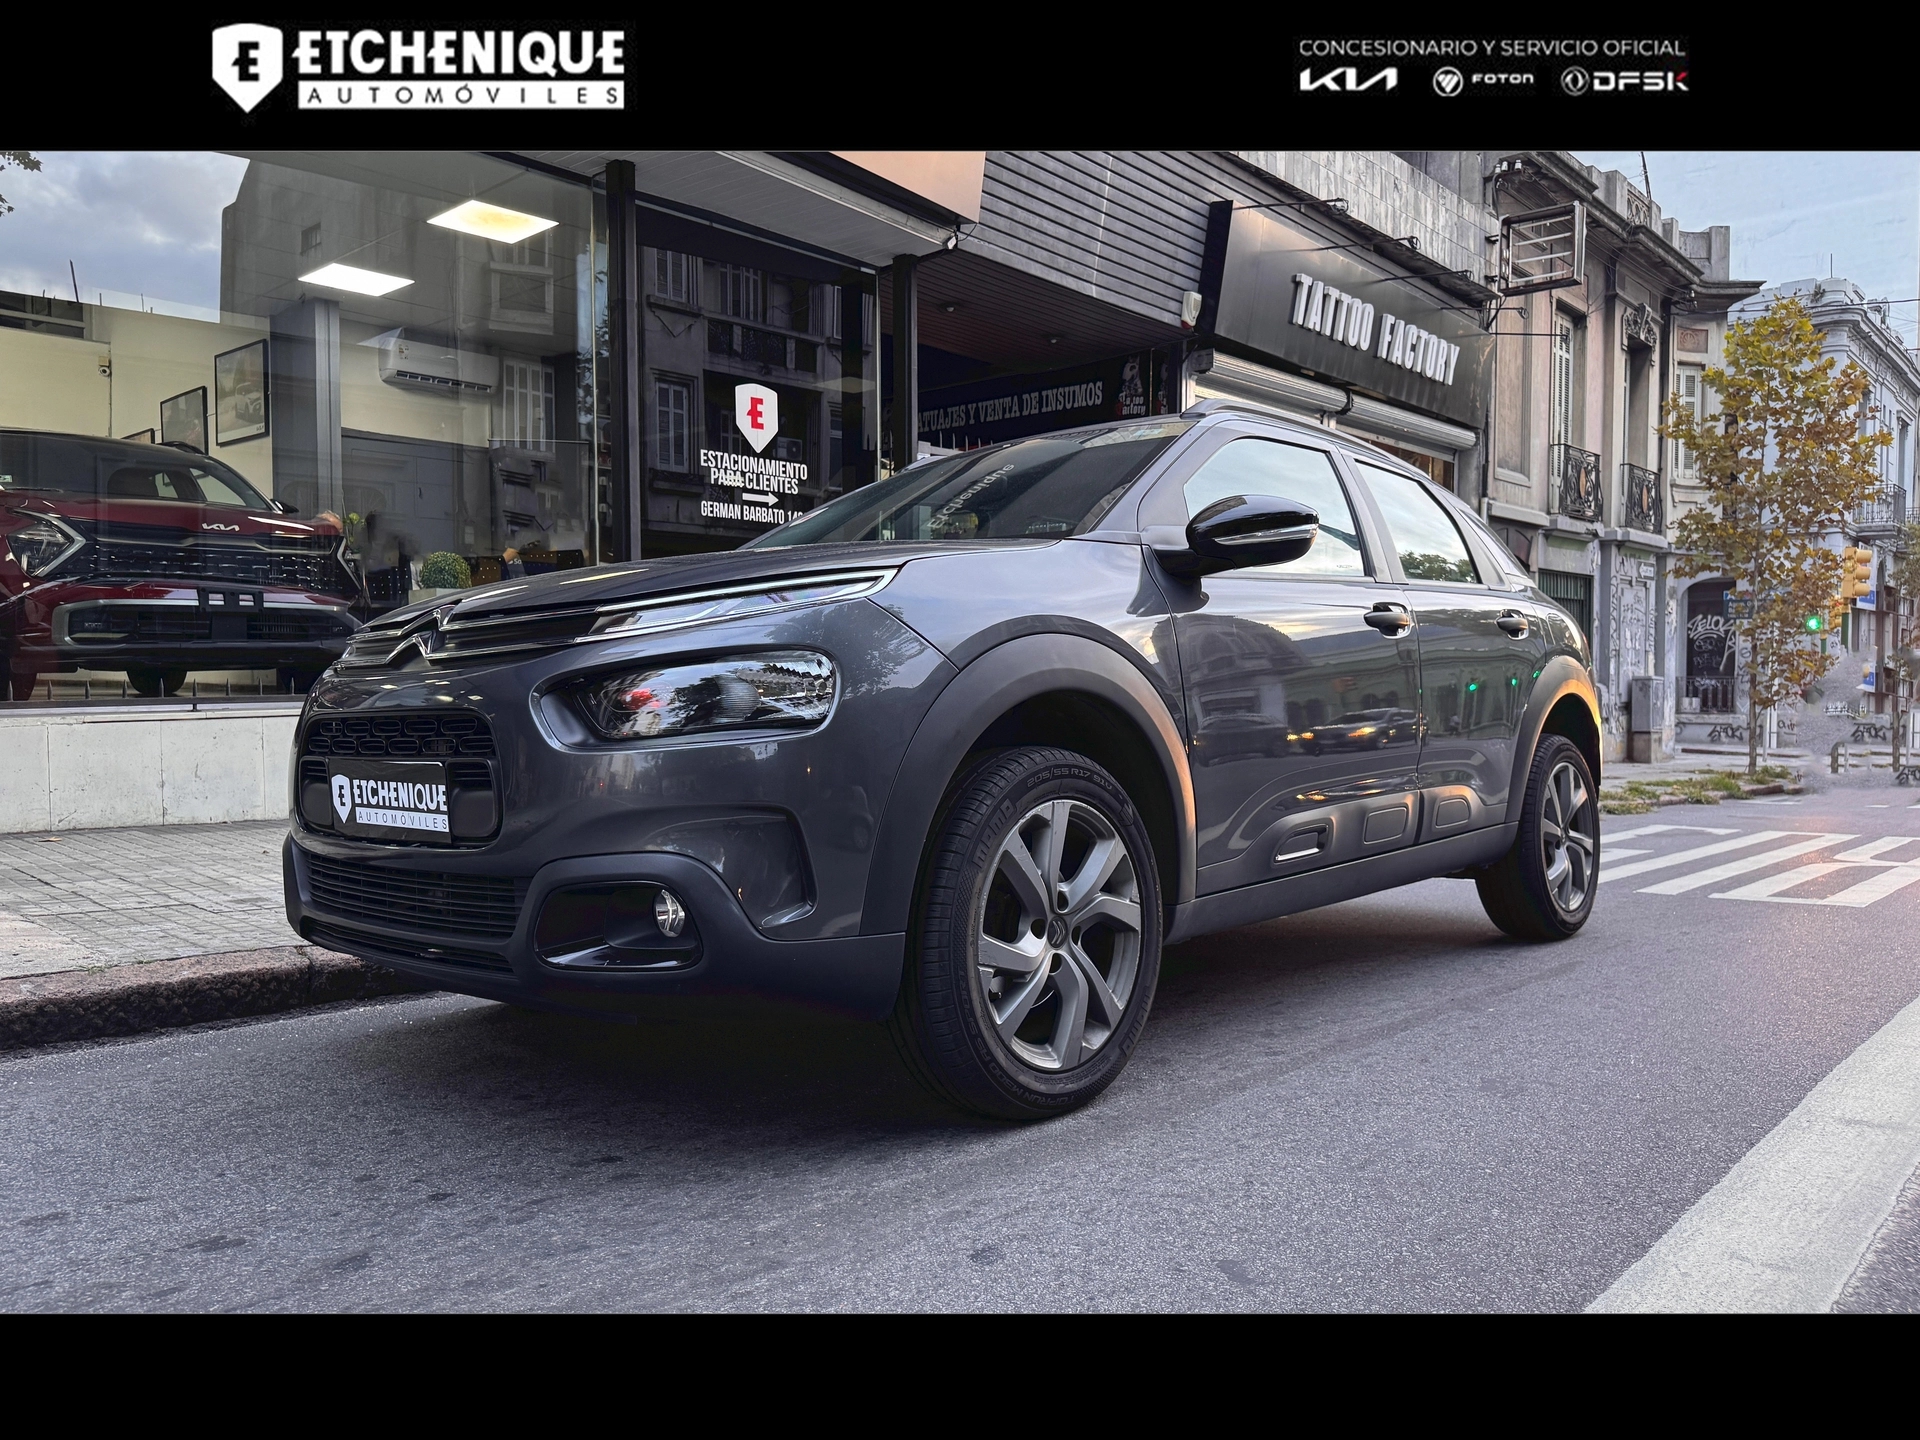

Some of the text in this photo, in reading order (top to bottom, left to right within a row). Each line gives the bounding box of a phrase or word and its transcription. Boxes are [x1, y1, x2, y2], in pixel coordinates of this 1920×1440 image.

[1293, 273, 1461, 386] TATTOO FACTORY
[917, 381, 1104, 434] ATUAJES Y VENTA DE INSUMOS
[700, 448, 809, 481] ESTACIONAMIENTO
[710, 467, 799, 495] PARA CLIENTES
[700, 500, 742, 520] GERMAN
[743, 504, 785, 525] BARBATO
[1027, 767, 1070, 788] 205/55
[1070, 768, 1091, 778] R17
[353, 779, 448, 812] ETCHENIQUE
[358, 811, 448, 830] AUTOMÓVILES
